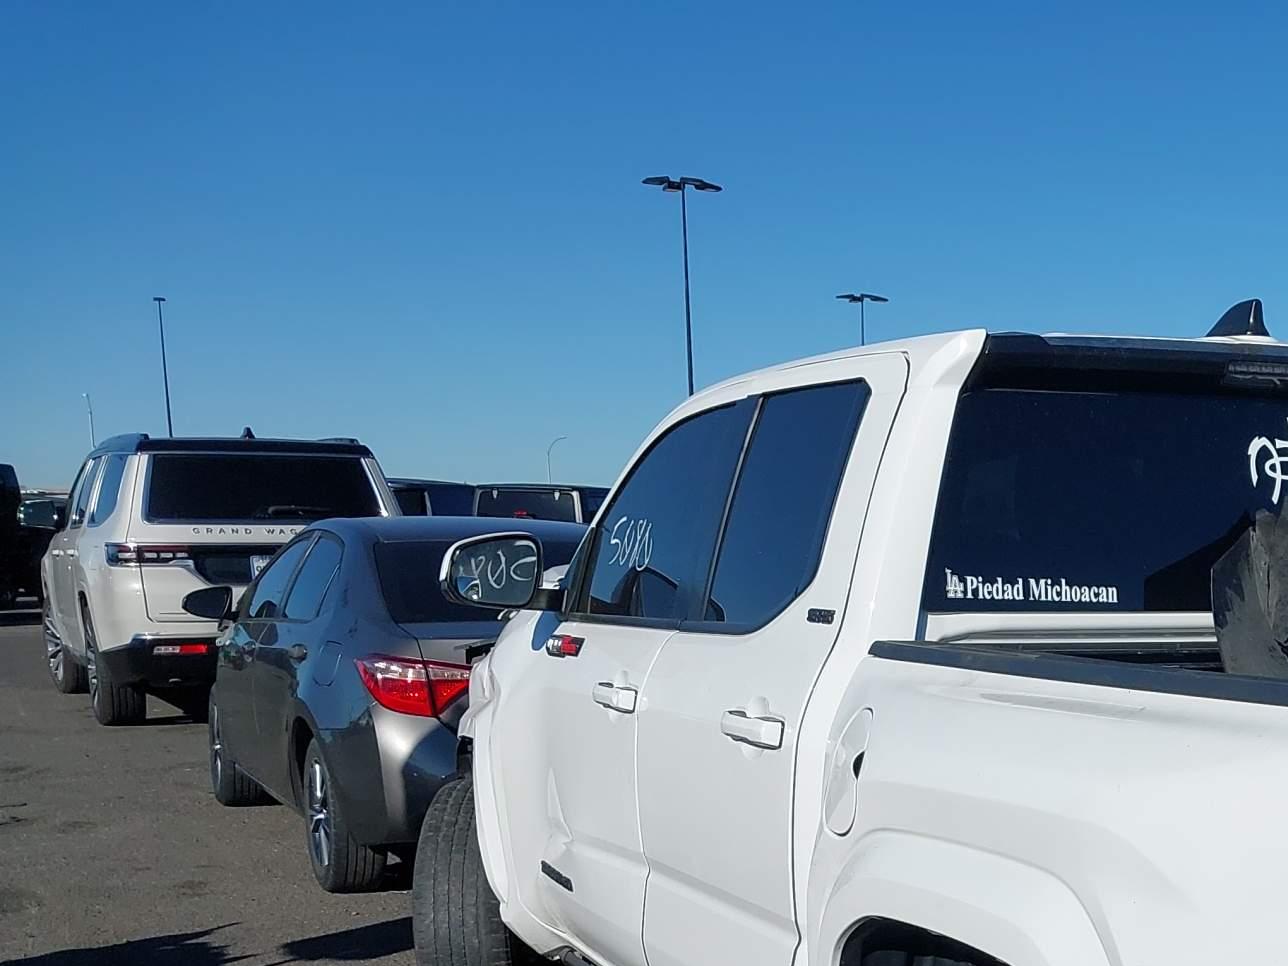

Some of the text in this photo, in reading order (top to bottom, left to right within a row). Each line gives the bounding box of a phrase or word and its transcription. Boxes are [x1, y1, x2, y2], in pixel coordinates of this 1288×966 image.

[192, 527, 252, 535] GRAND
[945, 567, 1118, 603] LA Piedad Michoacan
